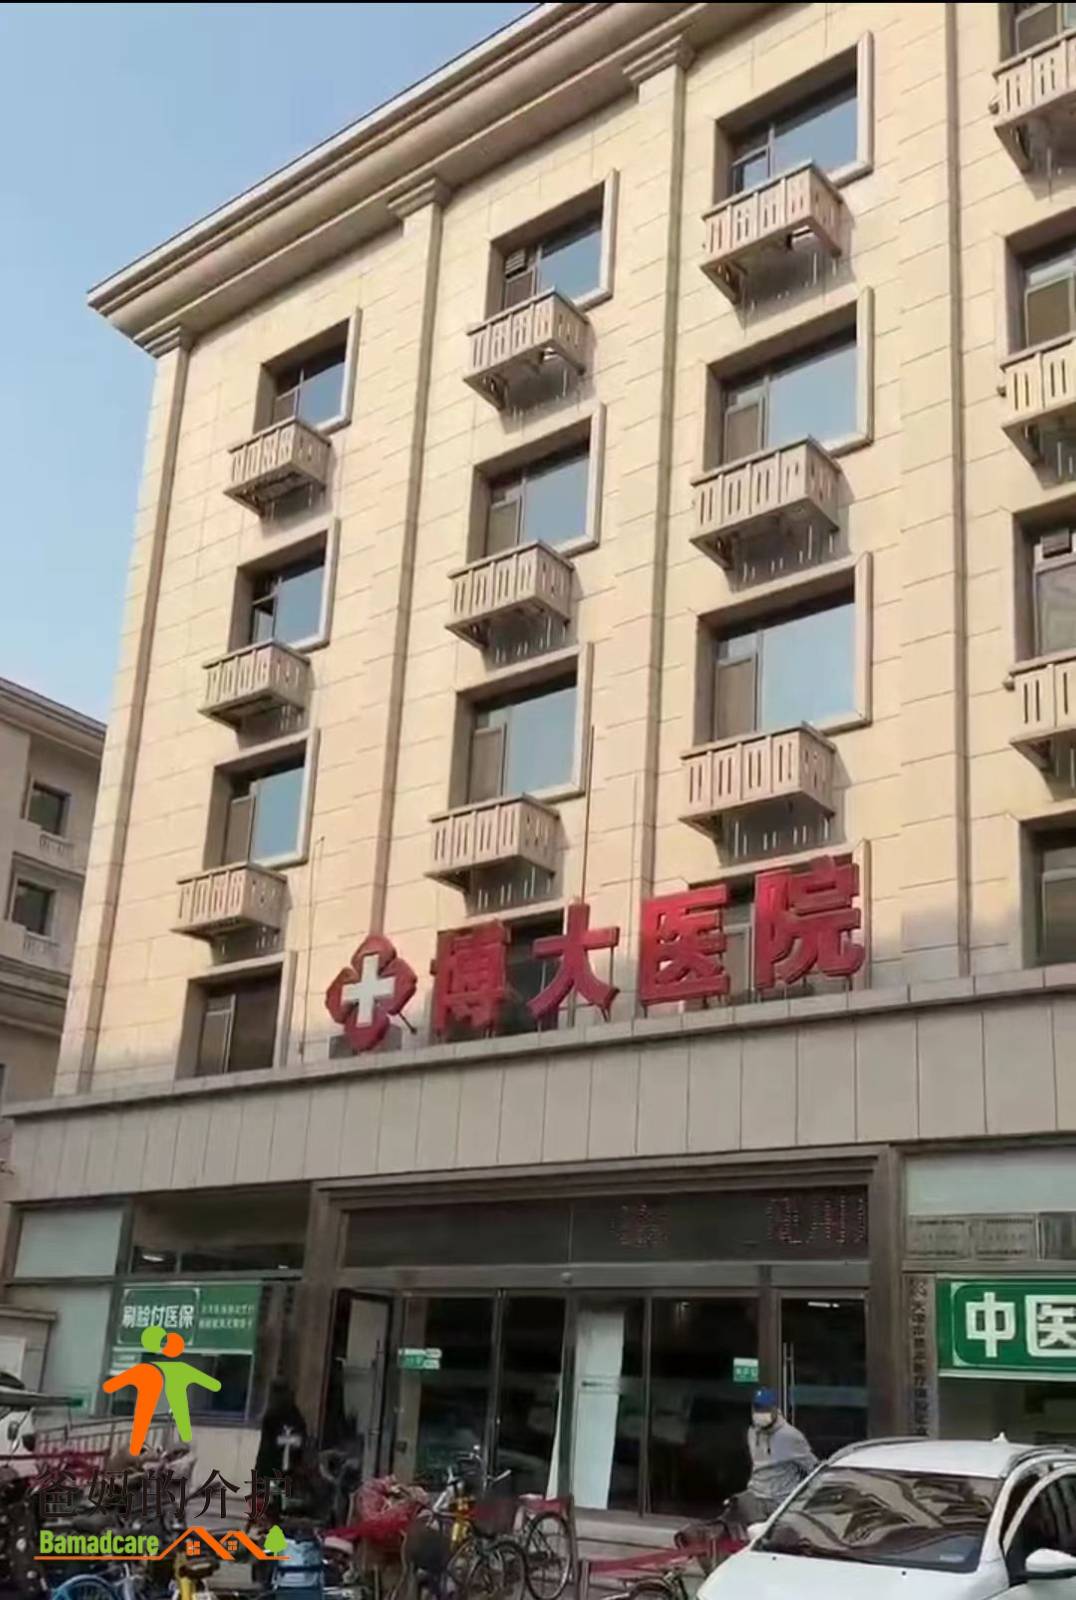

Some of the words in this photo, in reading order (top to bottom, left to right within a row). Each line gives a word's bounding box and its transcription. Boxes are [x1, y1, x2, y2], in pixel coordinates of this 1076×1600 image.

[430, 855, 865, 1038] 博大医院
[965, 1291, 1076, 1358] 中医
